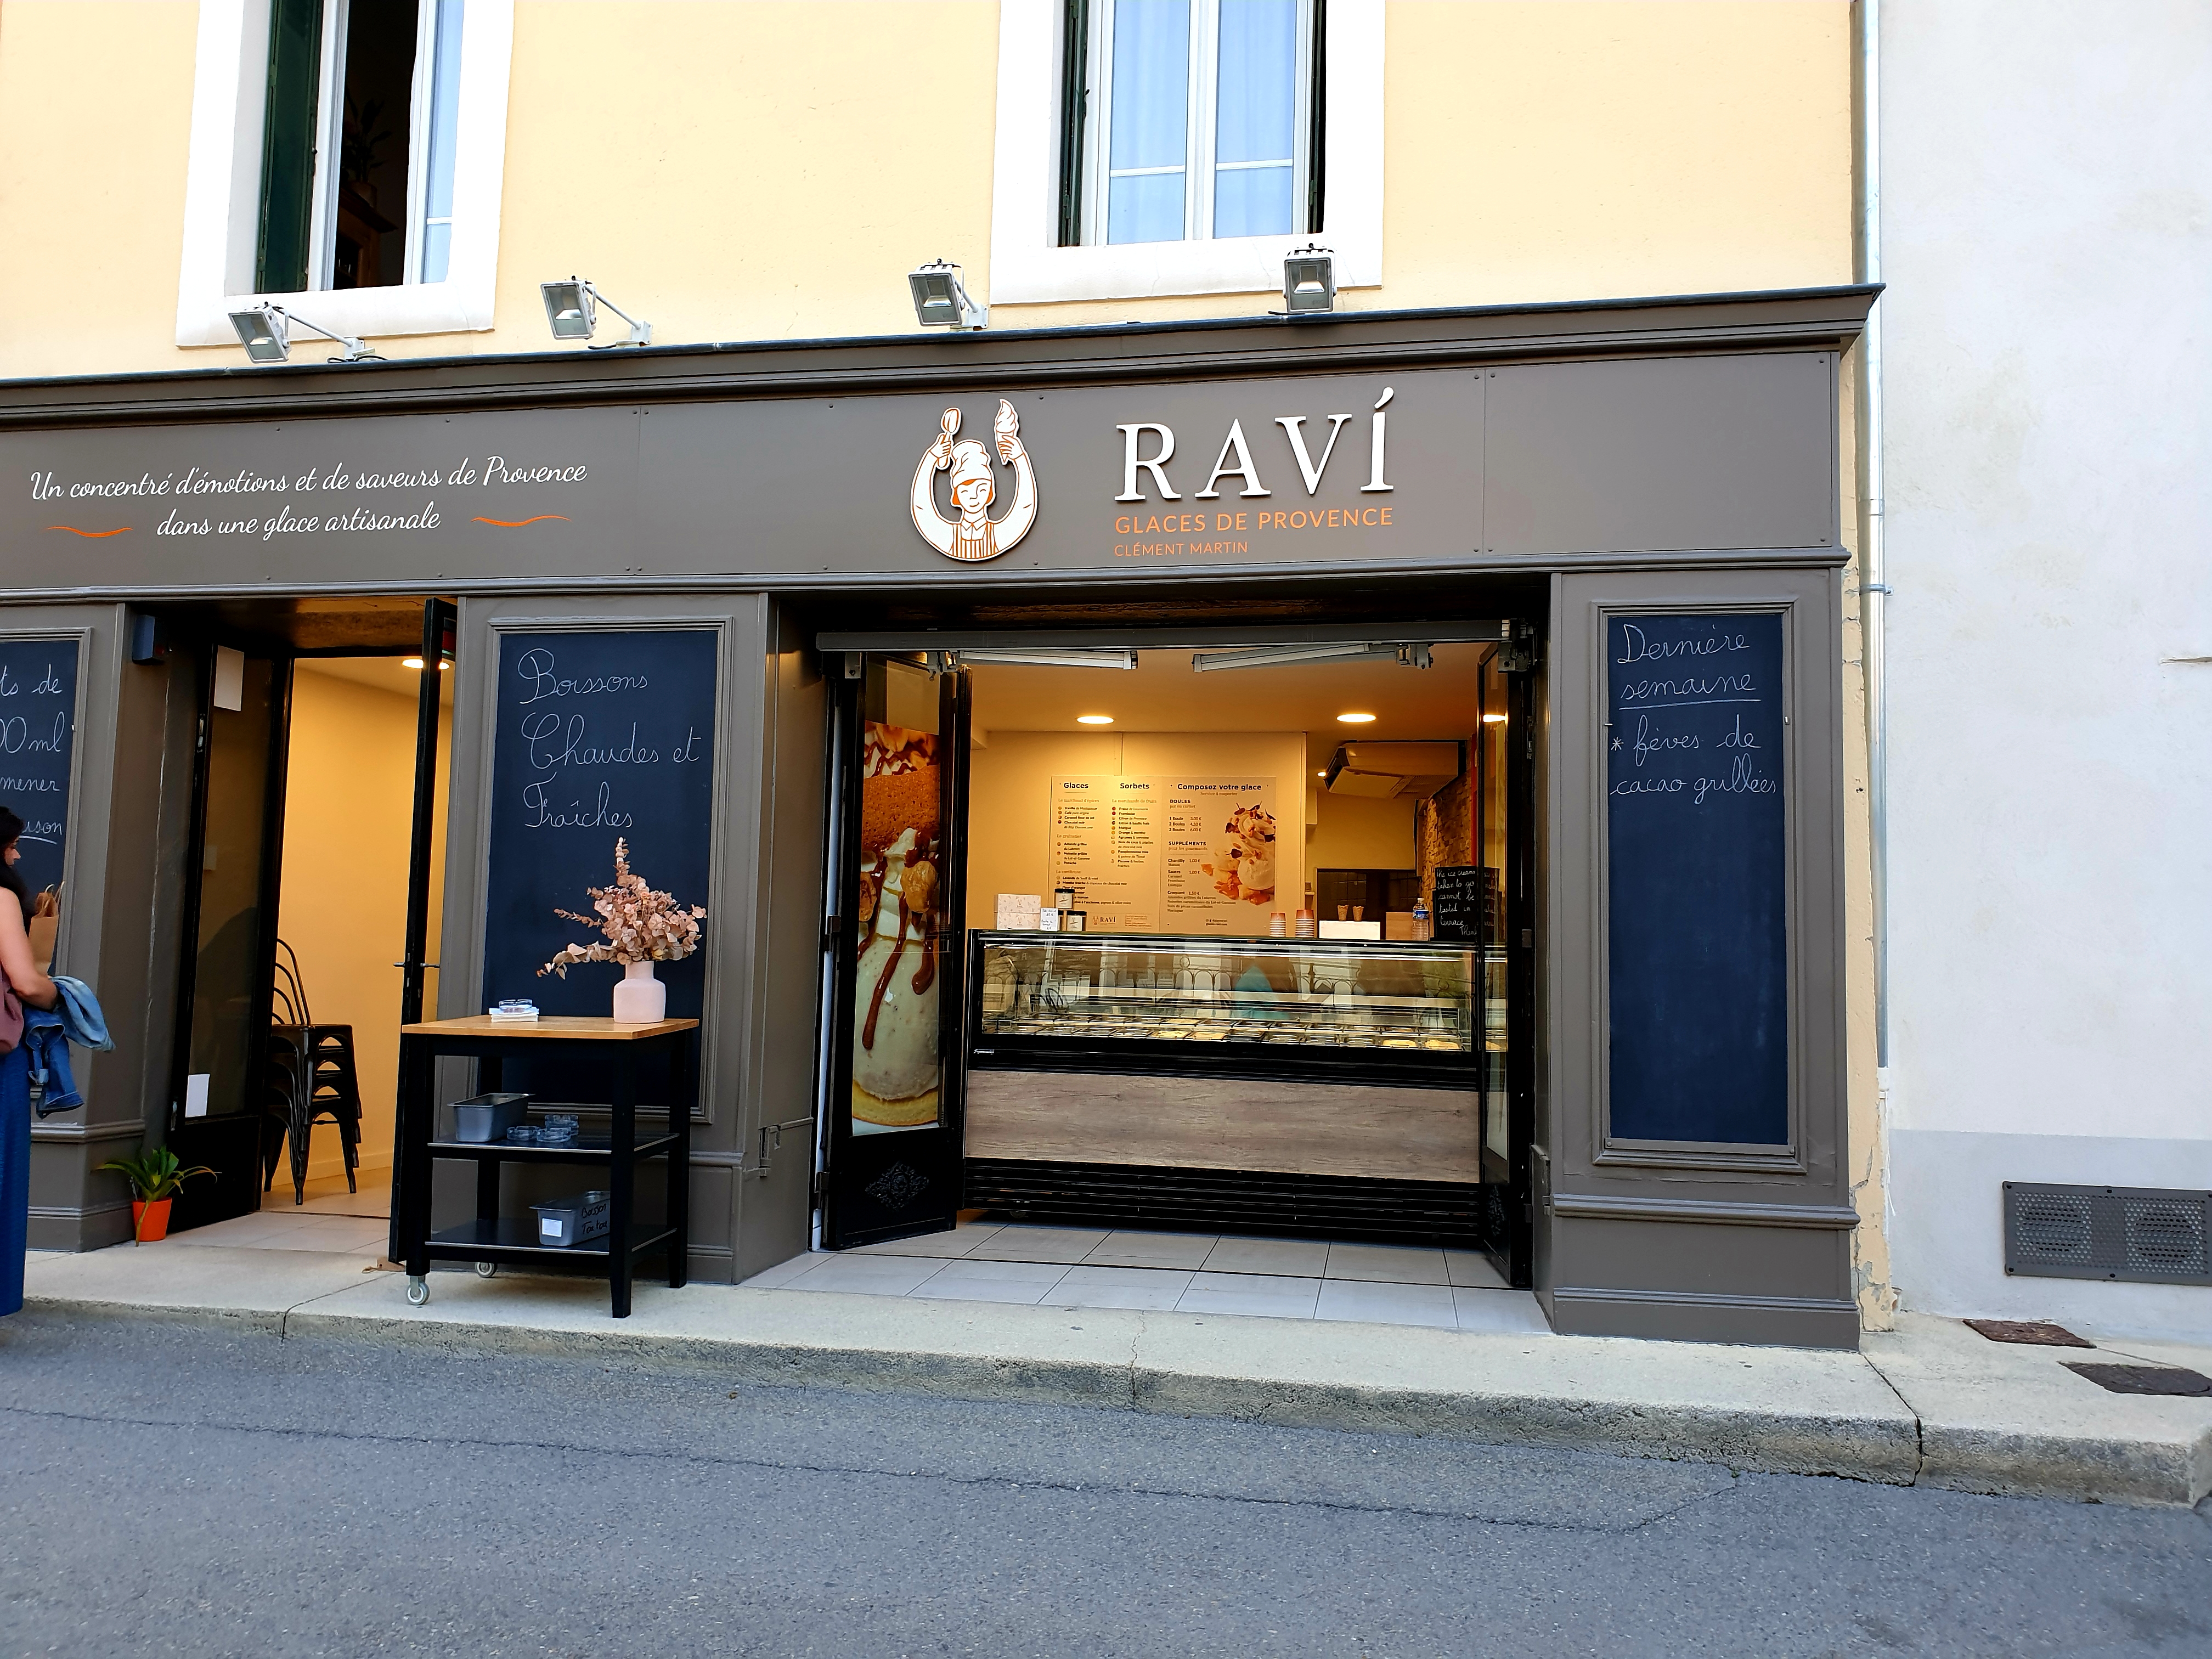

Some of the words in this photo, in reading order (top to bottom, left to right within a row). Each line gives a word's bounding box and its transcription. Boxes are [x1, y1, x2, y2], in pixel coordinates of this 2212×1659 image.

[1114, 386, 1395, 501] RAVÍ
[31, 471, 64, 500] Un
[70, 472, 172, 498] concentré
[176, 467, 290, 494] d'émotions
[295, 467, 318, 492] et
[322, 462, 351, 490] de
[356, 469, 443, 489] saveurs
[448, 457, 477, 486] de
[483, 456, 588, 486] Provence
[157, 508, 212, 536] dans
[218, 518, 258, 534] une
[263, 505, 320, 541] glace
[325, 500, 441, 532] artisanale
[1114, 514, 1206, 534] GLACES
[1216, 512, 1247, 532] DE
[1257, 507, 1392, 530] PROVENCE
[1114, 541, 1185, 557] CLÉMENT
[1189, 541, 1248, 554] MARTIN
[1617, 624, 1750, 664] Dernière
[0, 664, 19, 696] ts
[31, 663, 63, 694] de
[517, 648, 648, 704] Boissons
[1620, 674, 1757, 699] semaine
[521, 712, 659, 769] Chaudes
[672, 726, 702, 763] et
[1716, 714, 1762, 748] de
[0, 776, 60, 791] mener
[1610, 779, 1688, 795] cacao
[1694, 753, 1776, 805] grillées
[523, 771, 633, 828] Fraîches
[1456, 878, 1462, 887] to
[1465, 881, 1474, 892] go
[1466, 889, 1475, 901] be
